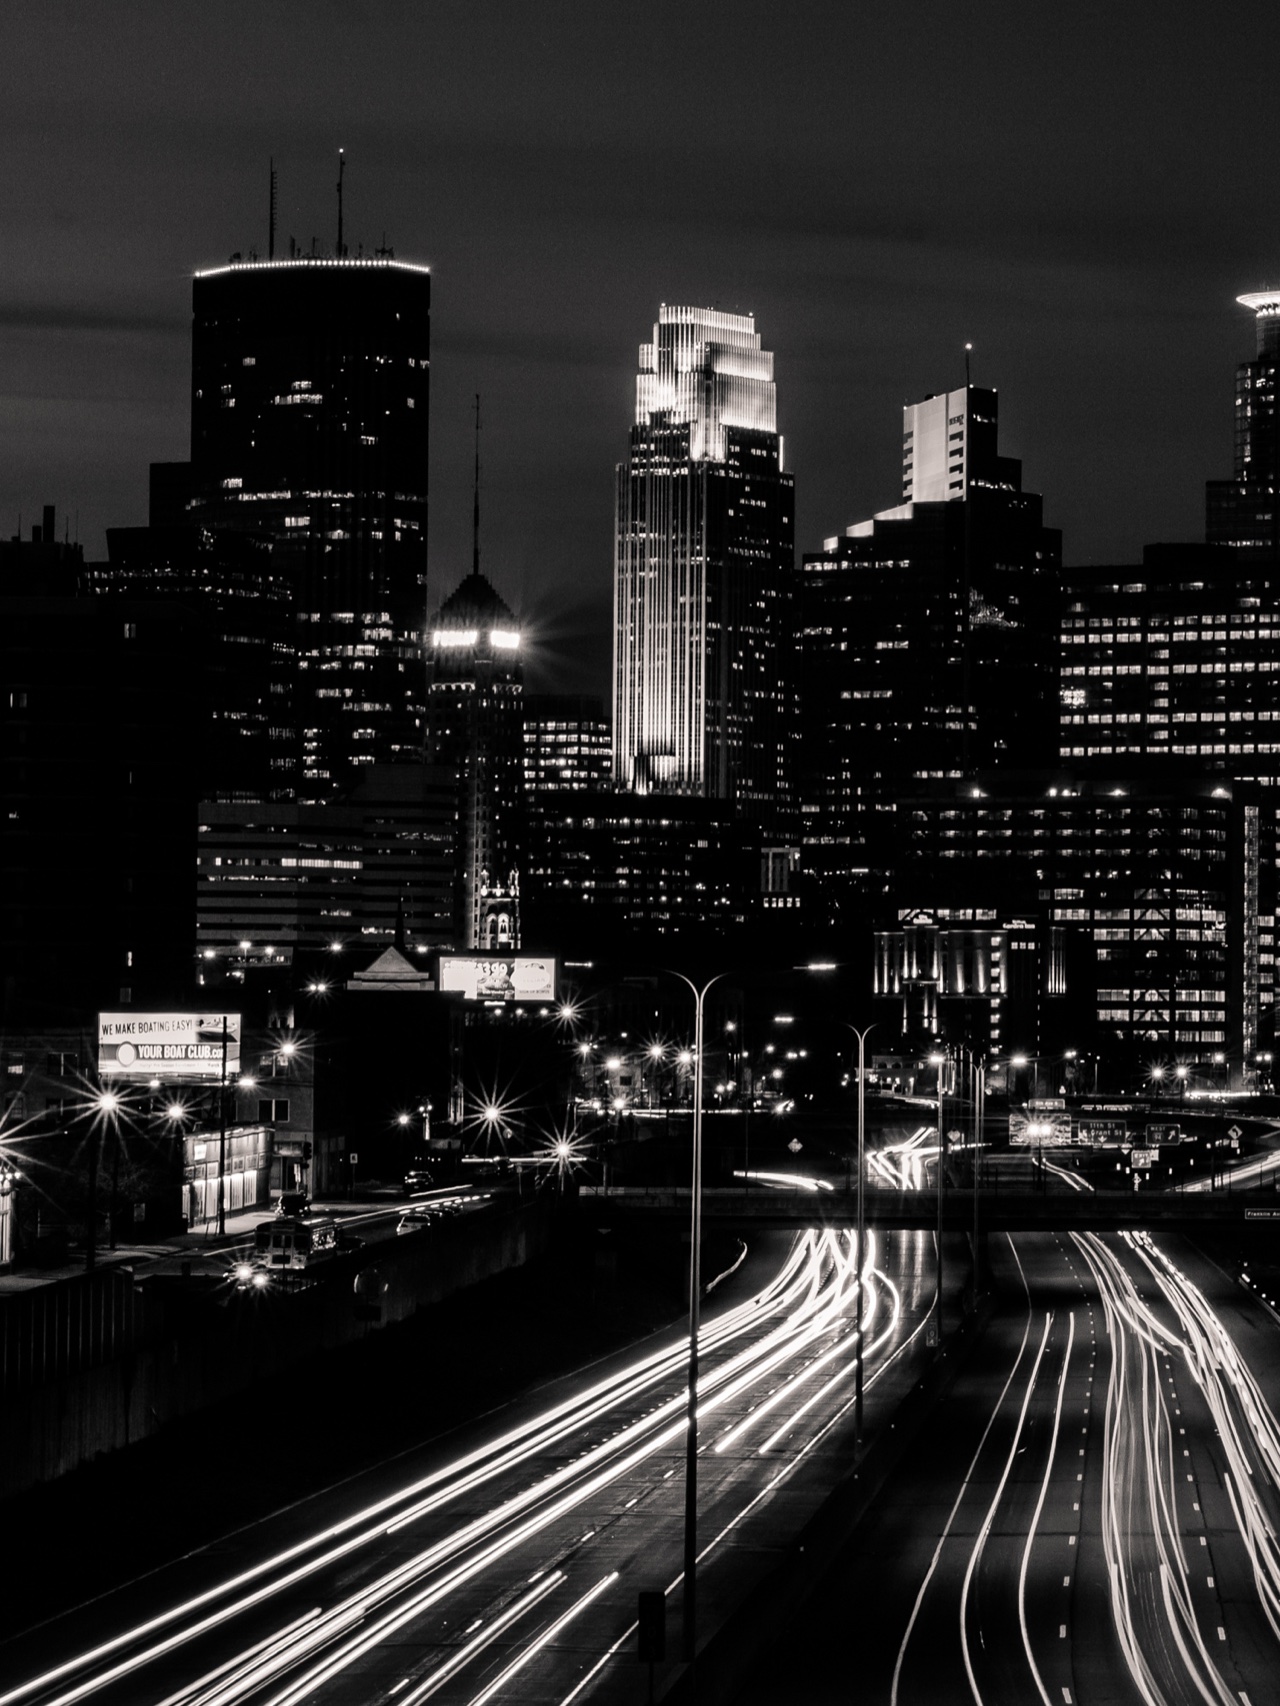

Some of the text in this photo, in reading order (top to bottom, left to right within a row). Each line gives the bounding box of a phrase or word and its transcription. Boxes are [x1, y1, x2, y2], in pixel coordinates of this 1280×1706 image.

[102, 1019, 193, 1036] WE MAKE BOATING EASY!
[138, 1045, 163, 1059] YOUR
[164, 1045, 187, 1059] BOAT
